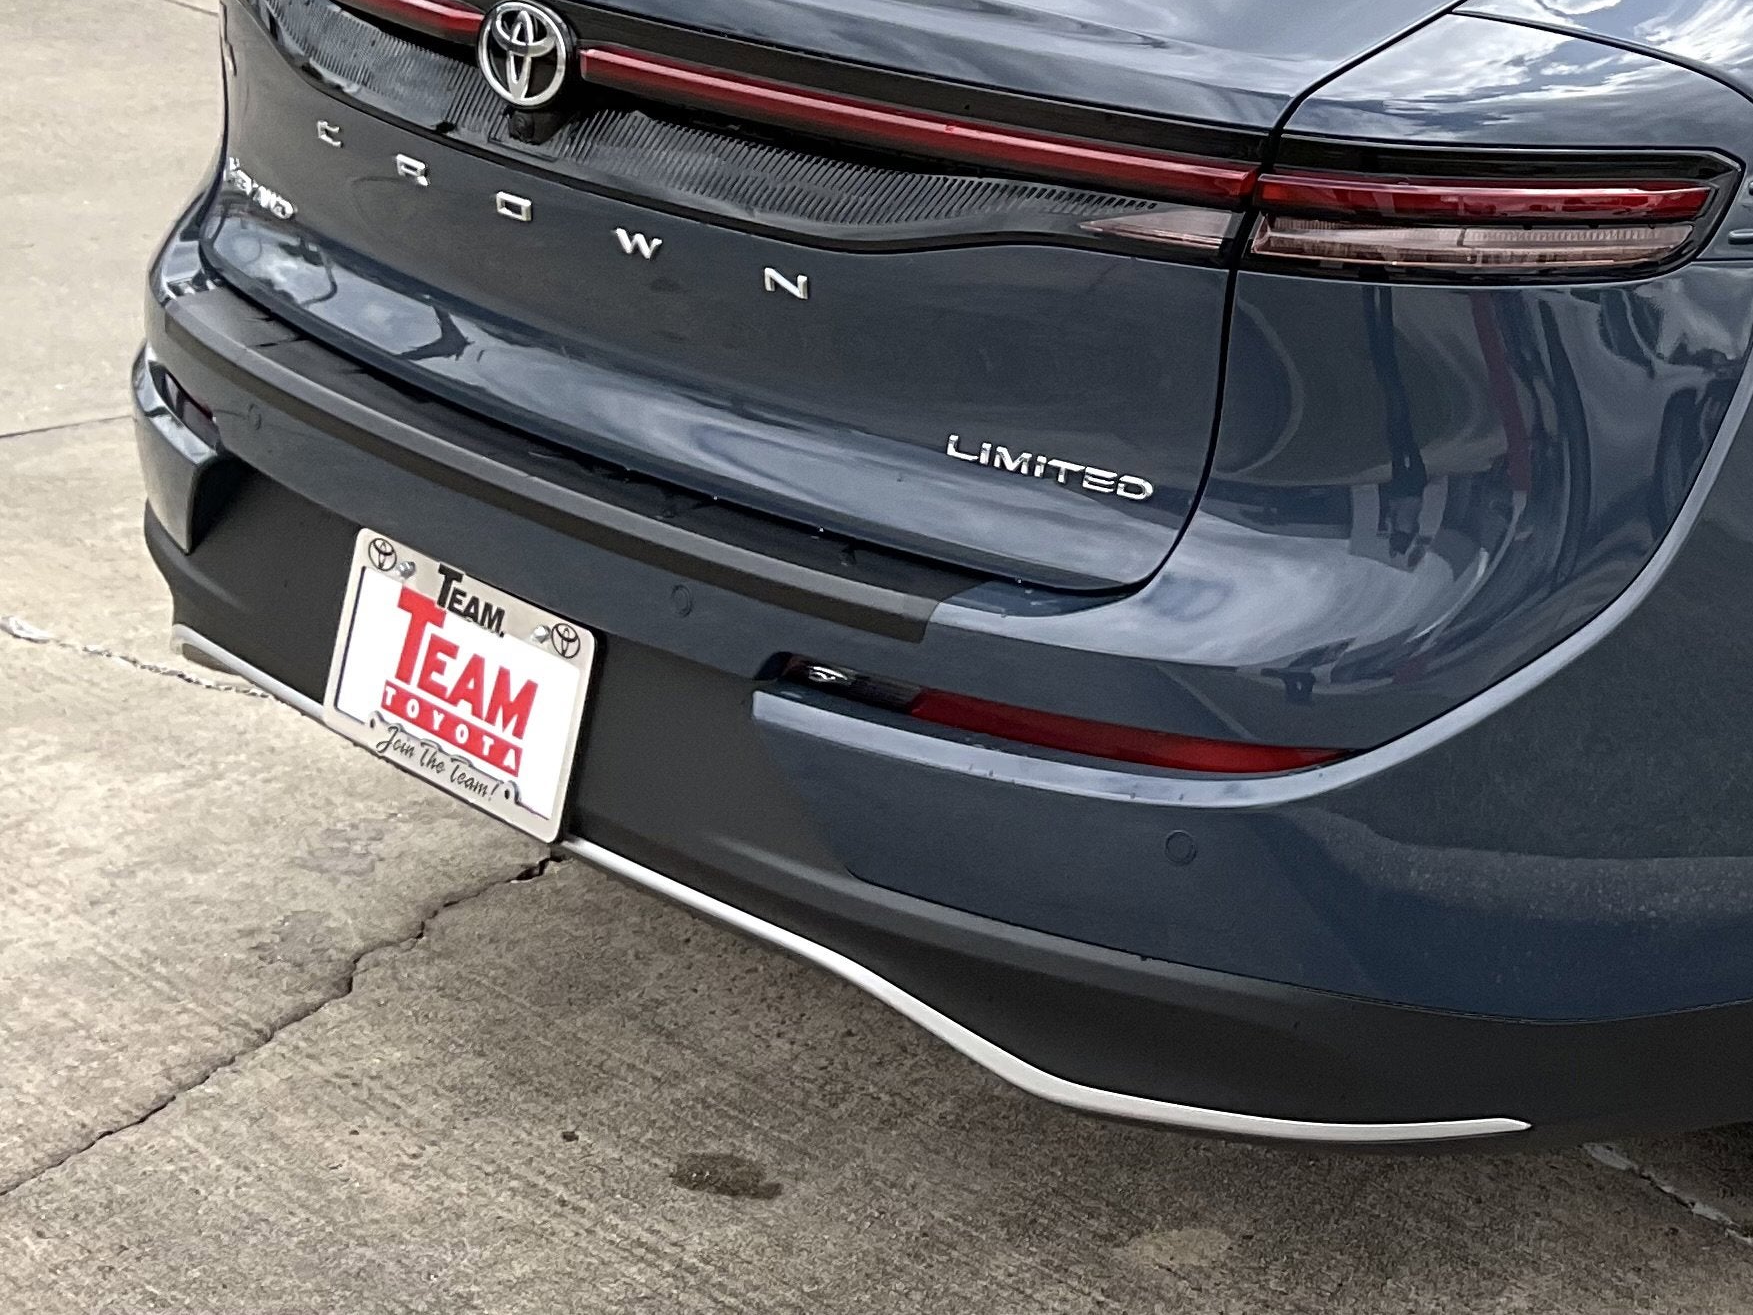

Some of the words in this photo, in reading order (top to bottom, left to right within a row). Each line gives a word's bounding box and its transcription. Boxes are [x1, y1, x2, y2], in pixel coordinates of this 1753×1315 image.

[316, 119, 809, 300] CROWN
[946, 435, 1154, 501] LIMITED
[395, 586, 538, 740] TEAM
[376, 725, 416, 758] Join
[384, 684, 518, 770] TOYOTA
